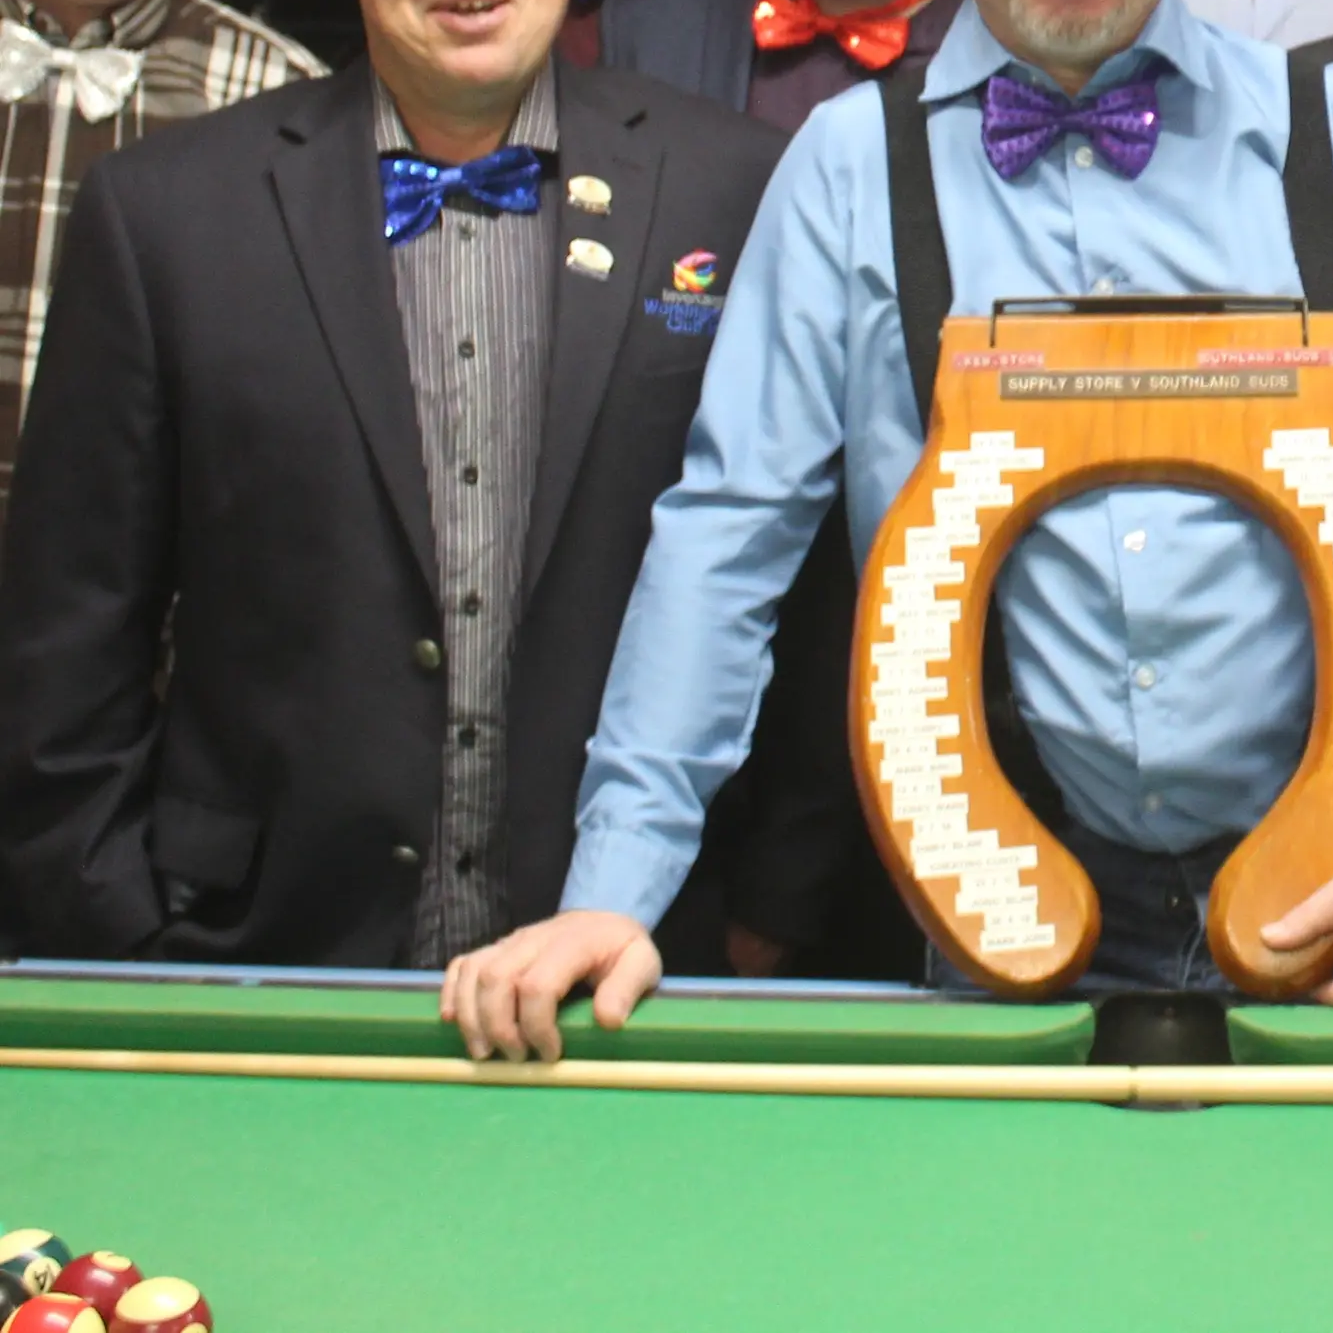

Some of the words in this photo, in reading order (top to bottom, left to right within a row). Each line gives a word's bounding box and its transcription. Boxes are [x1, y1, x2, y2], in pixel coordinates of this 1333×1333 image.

[1008, 377, 1068, 390] SUPPLY
[1074, 376, 1124, 390] STORE
[1130, 376, 1141, 389] V
[1150, 375, 1240, 389] SOUTHLAND
[1249, 375, 1289, 388] BUDS
